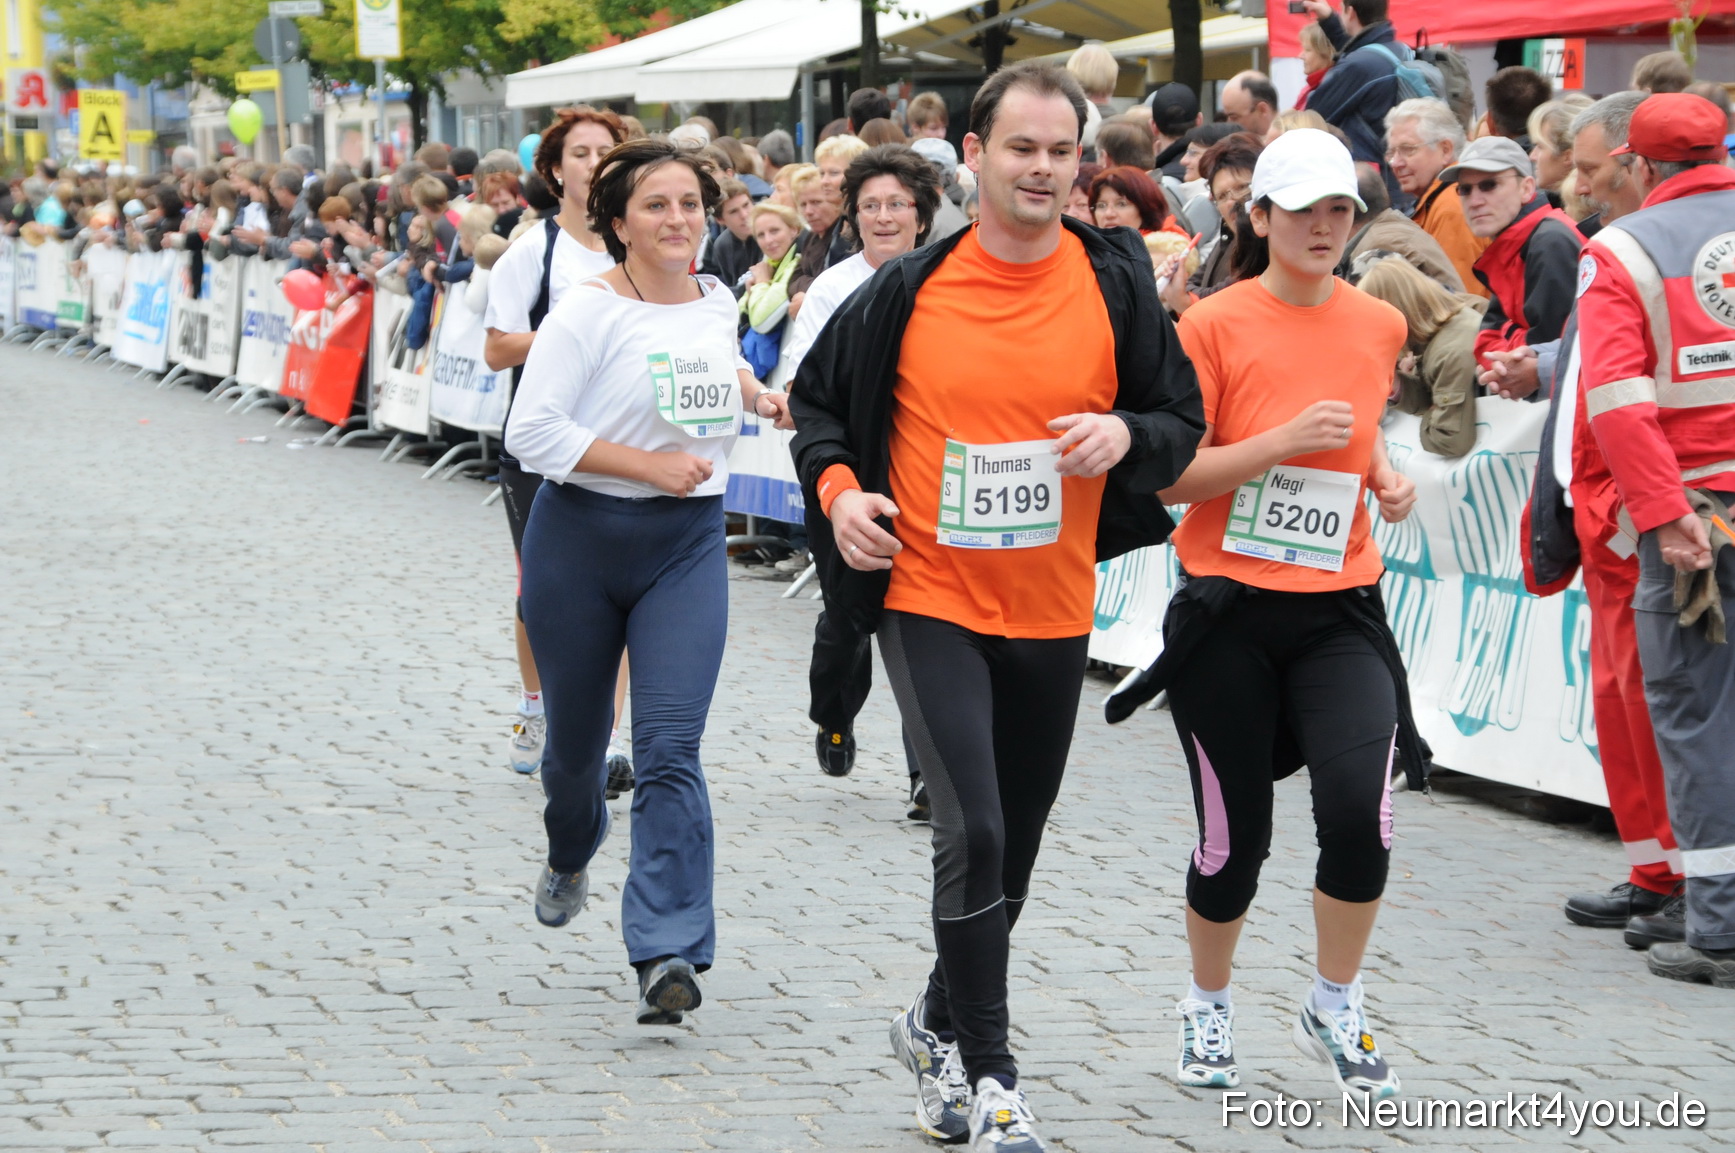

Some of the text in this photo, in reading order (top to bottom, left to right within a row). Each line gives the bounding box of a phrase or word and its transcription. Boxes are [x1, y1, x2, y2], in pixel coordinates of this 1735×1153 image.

[84, 93, 120, 105] Block
[90, 111, 114, 144] A
[1704, 239, 1735, 271] DEUT
[1704, 282, 1735, 318] ROTE
[675, 356, 709, 374] Gisela
[1687, 350, 1733, 366] Technik
[658, 385, 665, 398] S
[680, 383, 732, 409] 5097
[972, 455, 1031, 475] Thomas
[944, 481, 952, 496] S
[1270, 472, 1306, 496] Nagi
[973, 482, 1050, 515] 5199
[1237, 493, 1247, 508] S
[1265, 501, 1340, 538] 5200
[1015, 528, 1057, 541] PFLEIDERER
[1297, 550, 1341, 565] PFLEIDERER
[831, 732, 842, 745] S
[1360, 1033, 1375, 1052] S
[995, 1109, 1012, 1123] S
